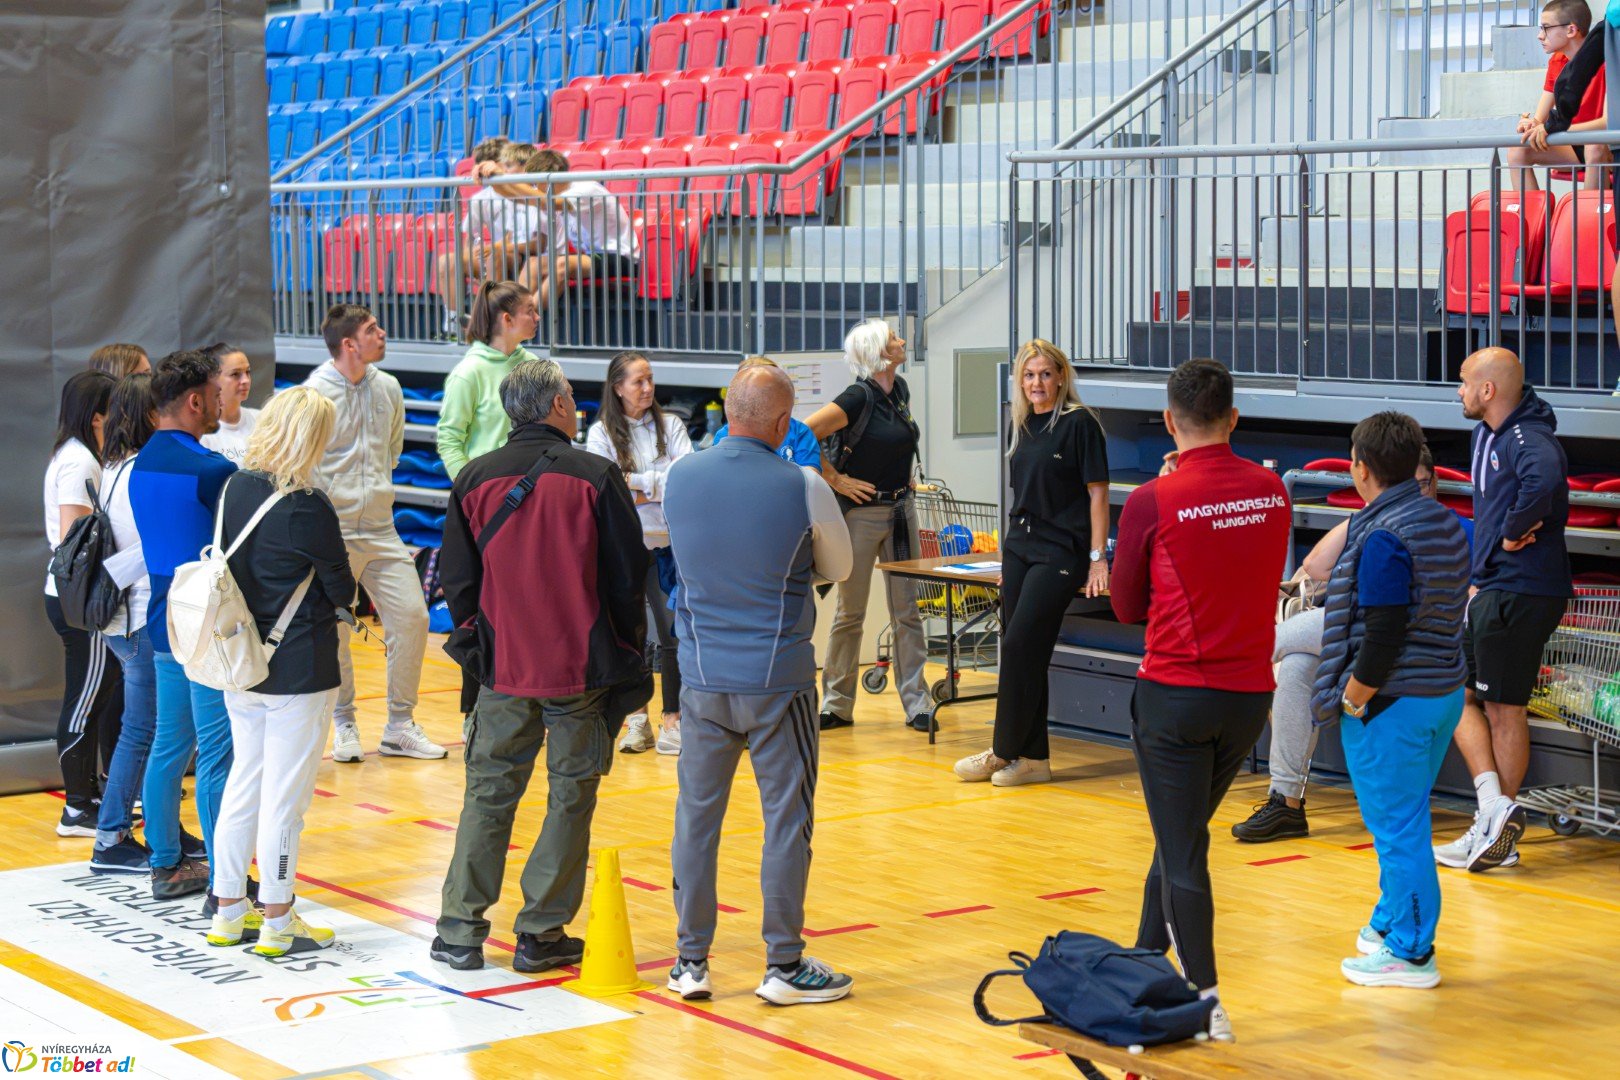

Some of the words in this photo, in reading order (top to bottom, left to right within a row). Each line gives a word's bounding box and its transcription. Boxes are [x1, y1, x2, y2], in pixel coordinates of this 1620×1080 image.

[1177, 494, 1286, 523] MAGYARORSZÁG
[1212, 513, 1267, 530] HUNGARY
[278, 854, 289, 880] PUMA
[28, 899, 263, 985] NYÍREGYHÁZI
